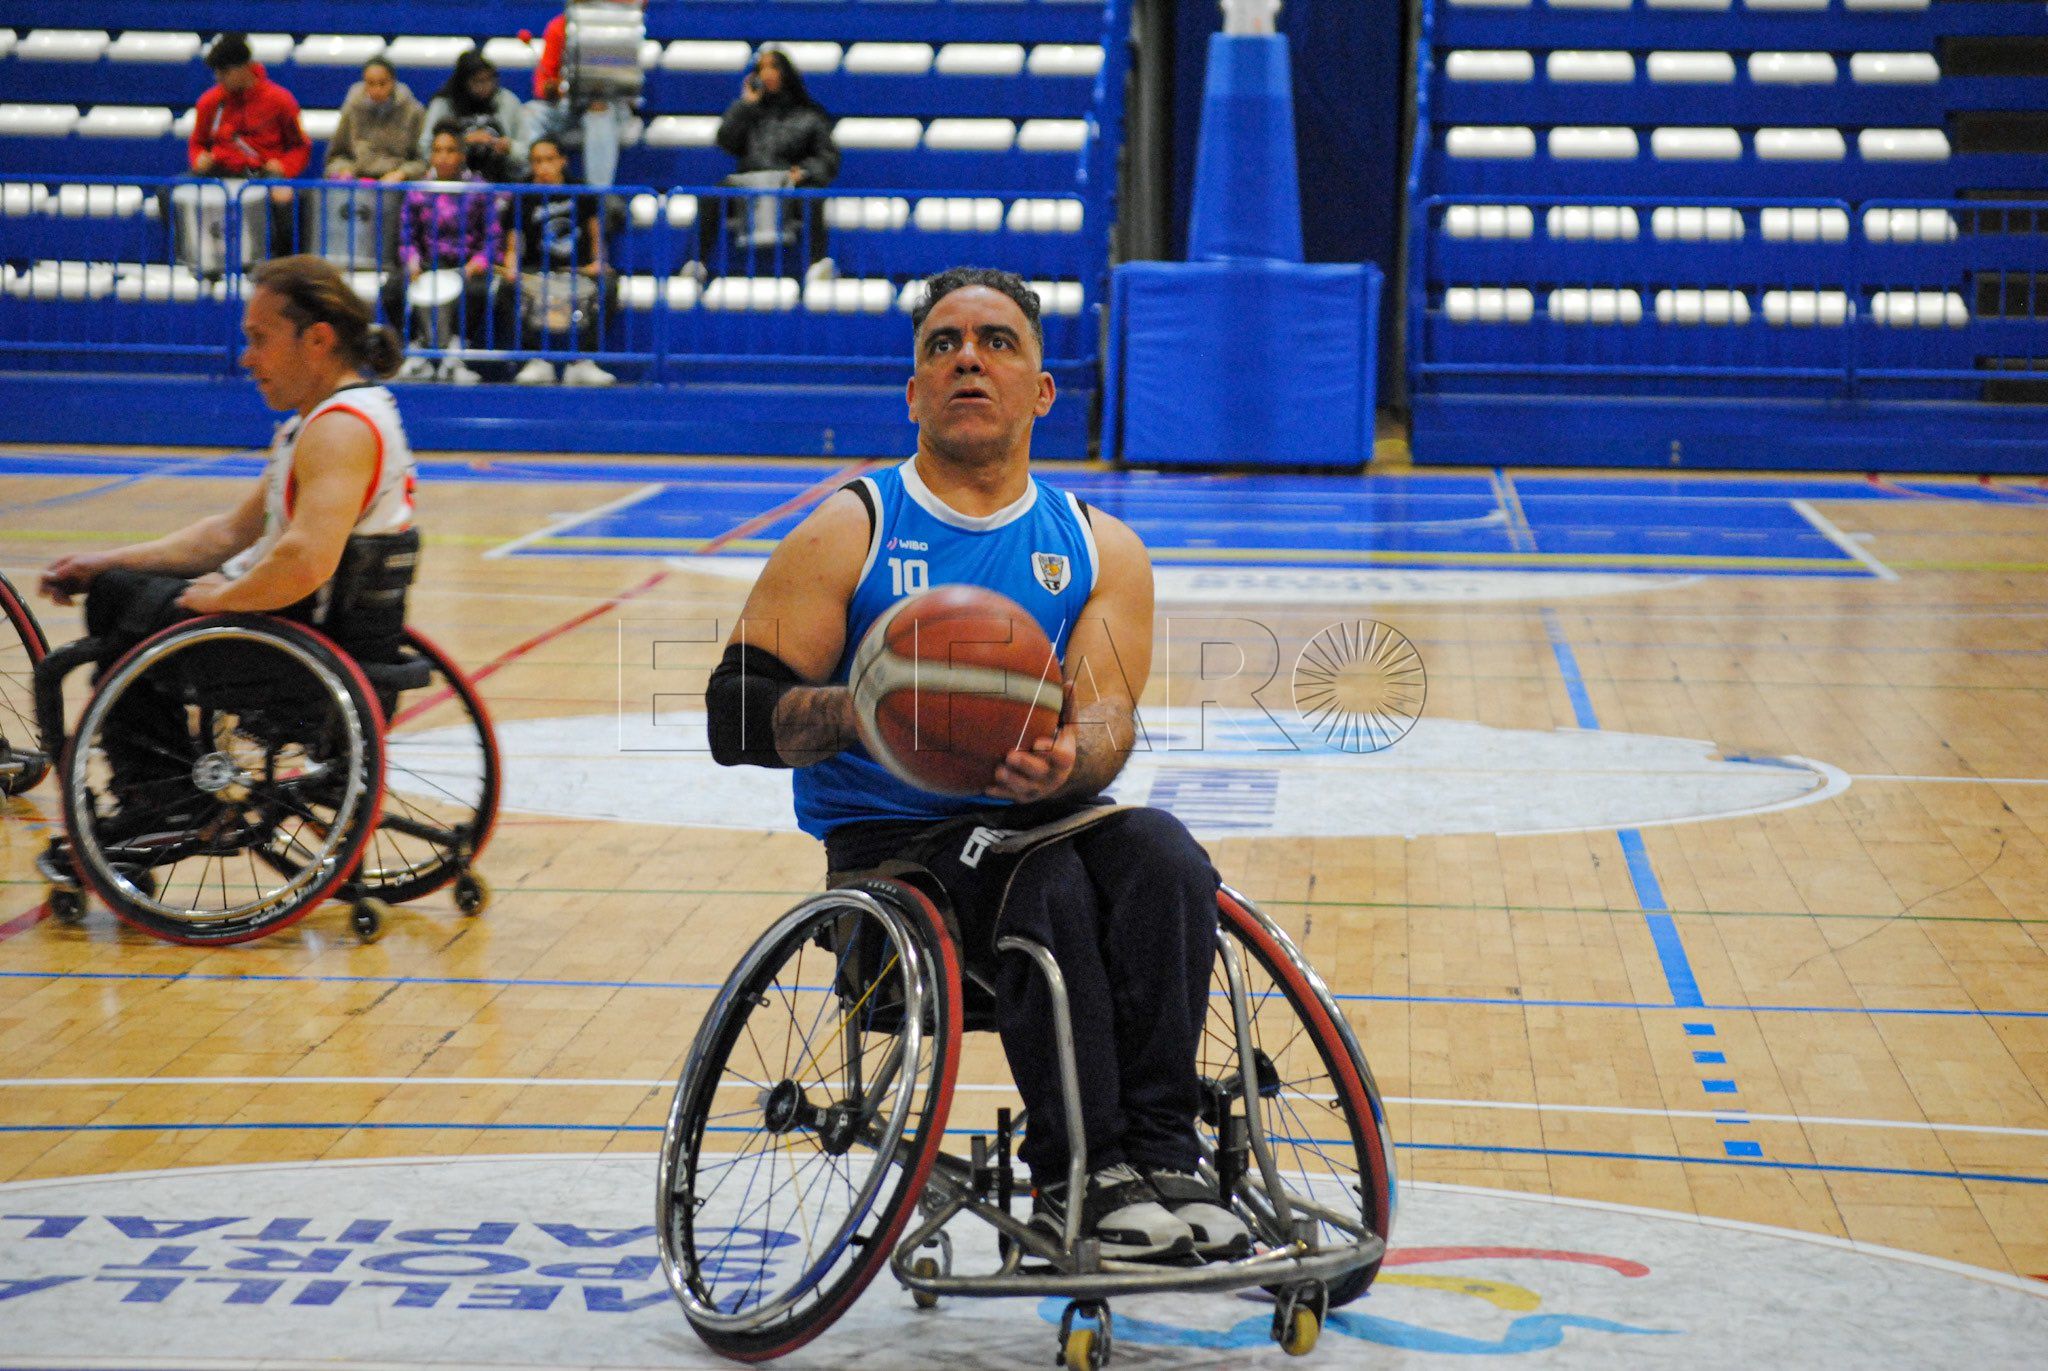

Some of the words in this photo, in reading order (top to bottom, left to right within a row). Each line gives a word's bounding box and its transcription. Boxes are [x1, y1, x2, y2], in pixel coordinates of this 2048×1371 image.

[887, 557, 929, 596] 10
[1, 1214, 802, 1250] CAPITAL
[101, 1244, 784, 1282] SPORT
